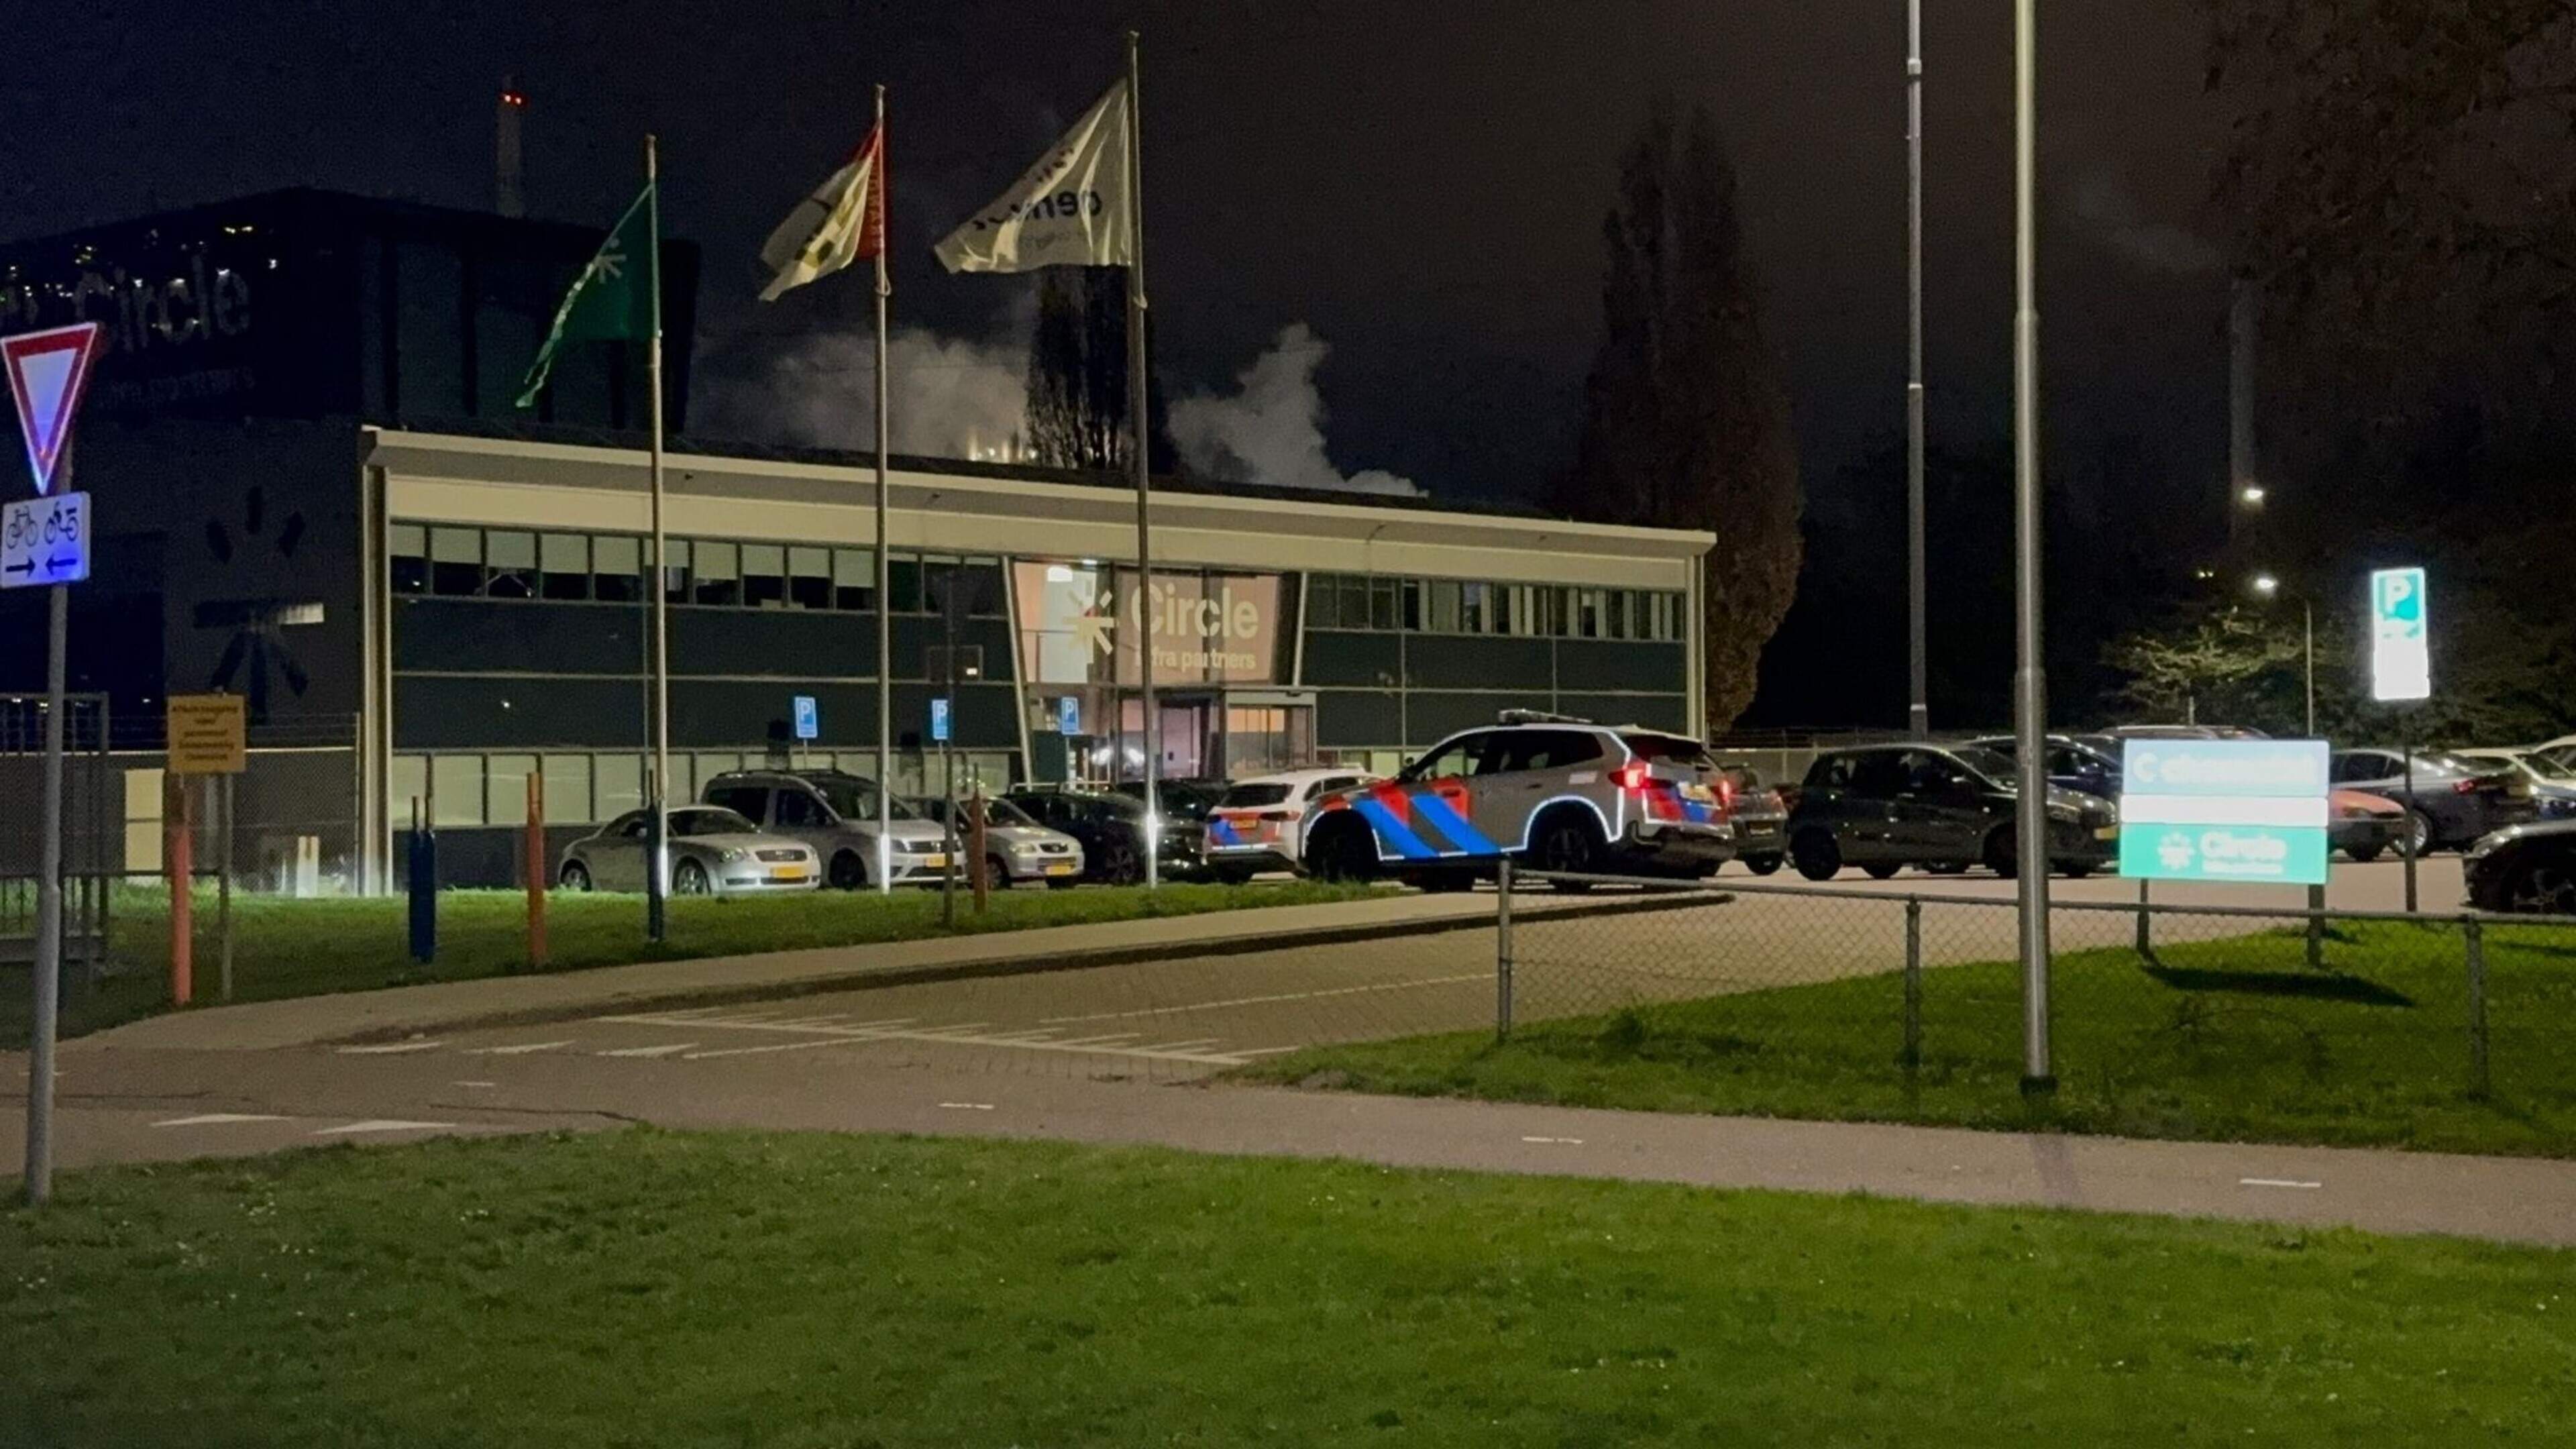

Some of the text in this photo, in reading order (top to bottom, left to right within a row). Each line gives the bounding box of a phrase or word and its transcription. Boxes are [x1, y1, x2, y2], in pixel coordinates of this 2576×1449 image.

[2385, 576, 2412, 614] P
[1131, 582, 1259, 639] Circle
[1181, 648, 1257, 674] partners
[800, 702, 811, 721] P
[937, 704, 947, 723] P
[1065, 702, 1075, 720] P
